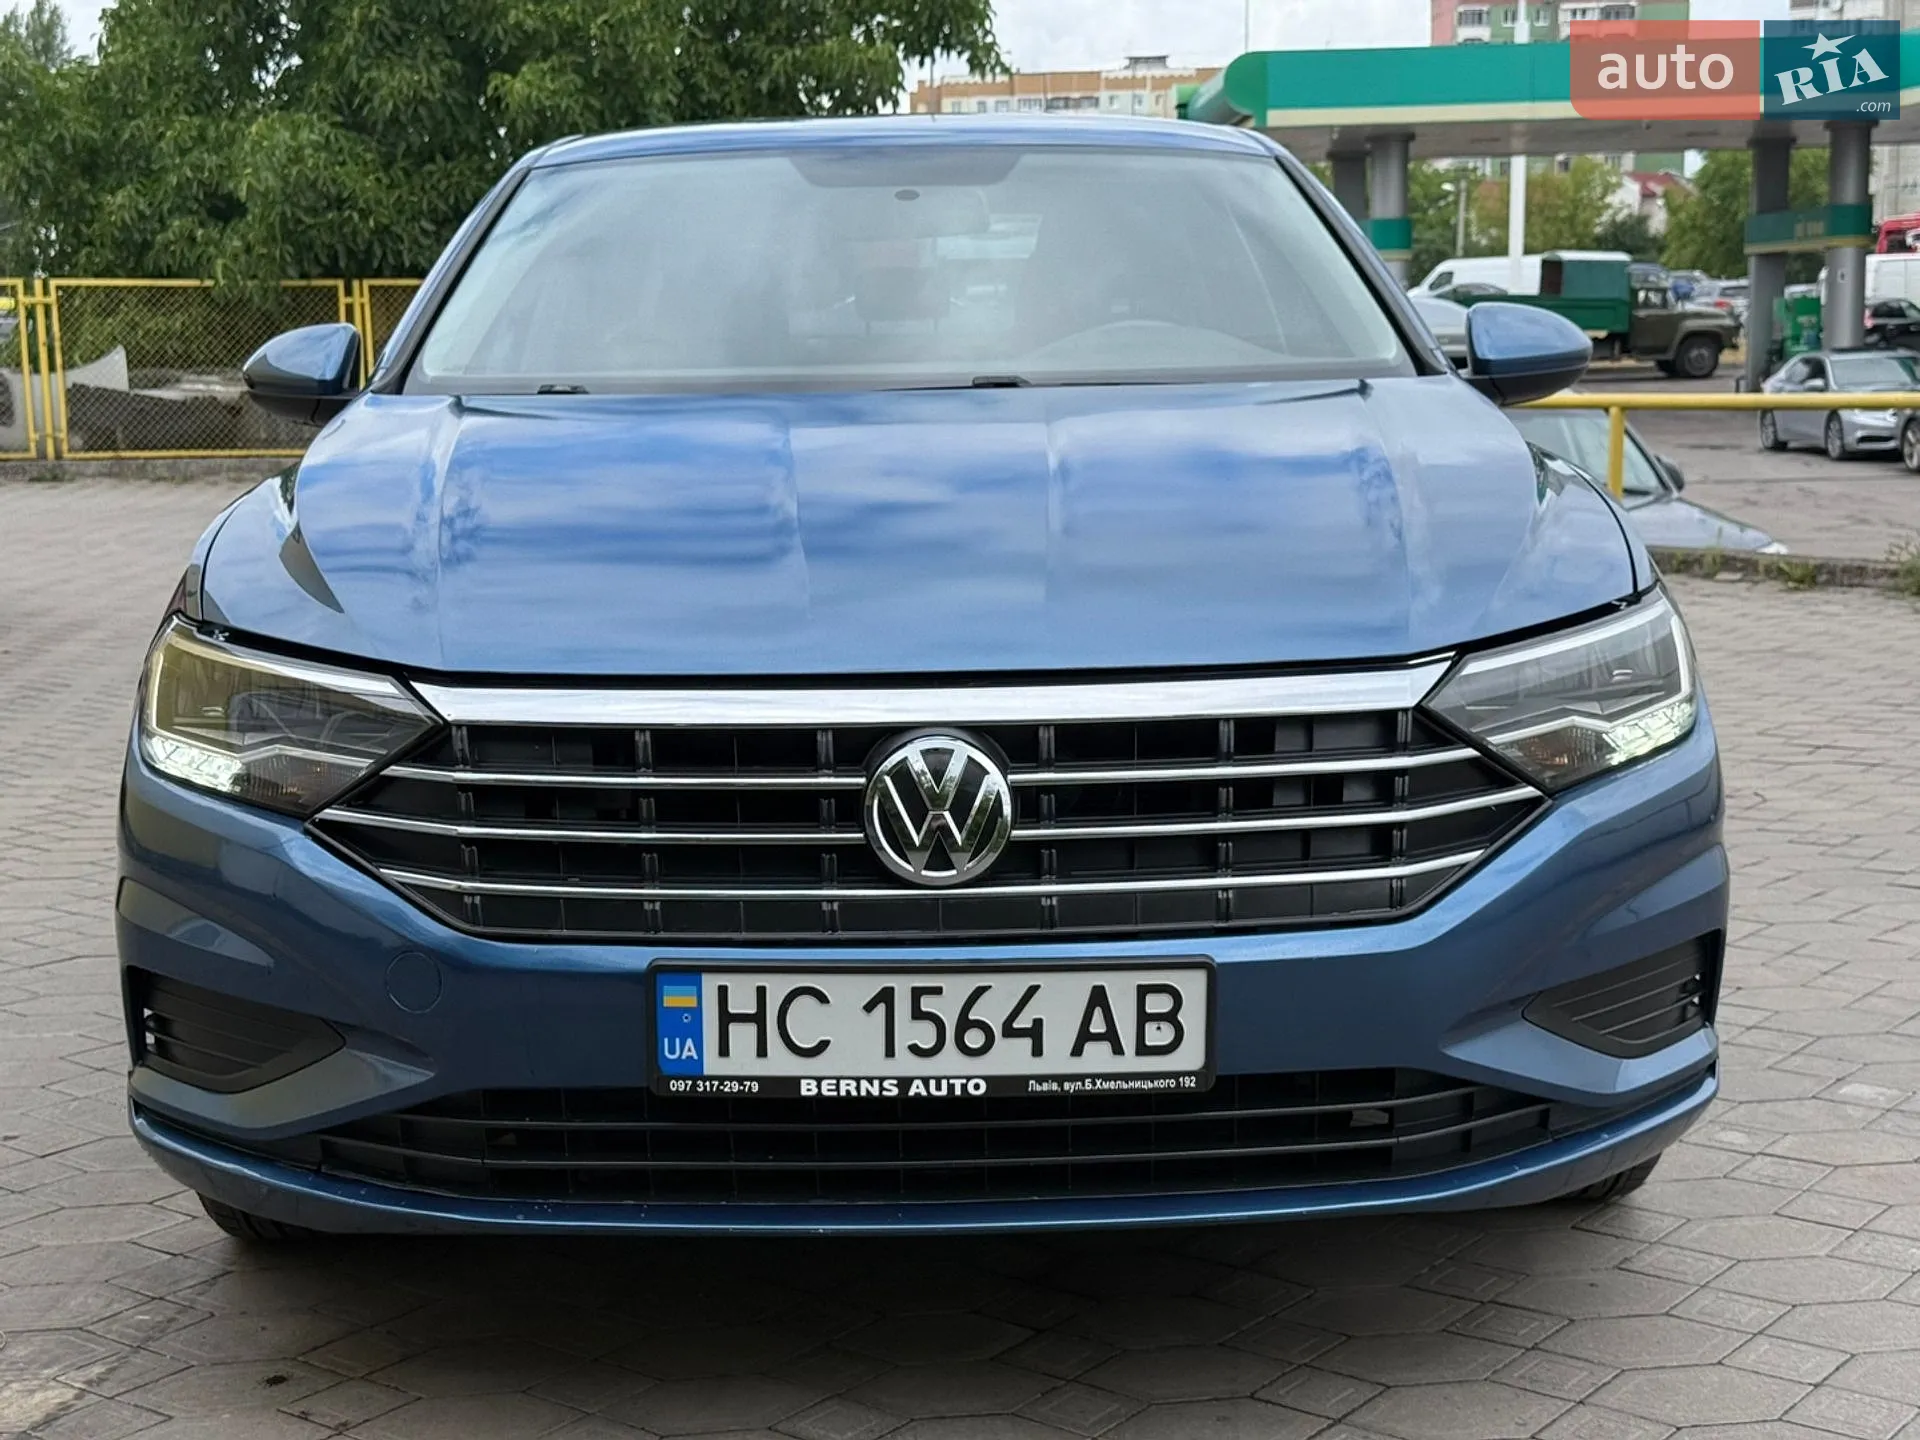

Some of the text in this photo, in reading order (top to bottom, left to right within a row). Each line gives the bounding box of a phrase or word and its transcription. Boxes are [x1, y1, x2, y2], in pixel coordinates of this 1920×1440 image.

[717, 984, 1185, 1058] HC 1564 AB
[664, 1037, 698, 1061] UA
[669, 1080, 759, 1093] 097 317-29-79
[800, 1078, 987, 1097] BERNS AUTO
[1028, 1079, 1061, 1092] Львів,
[1179, 1076, 1196, 1088] 192
